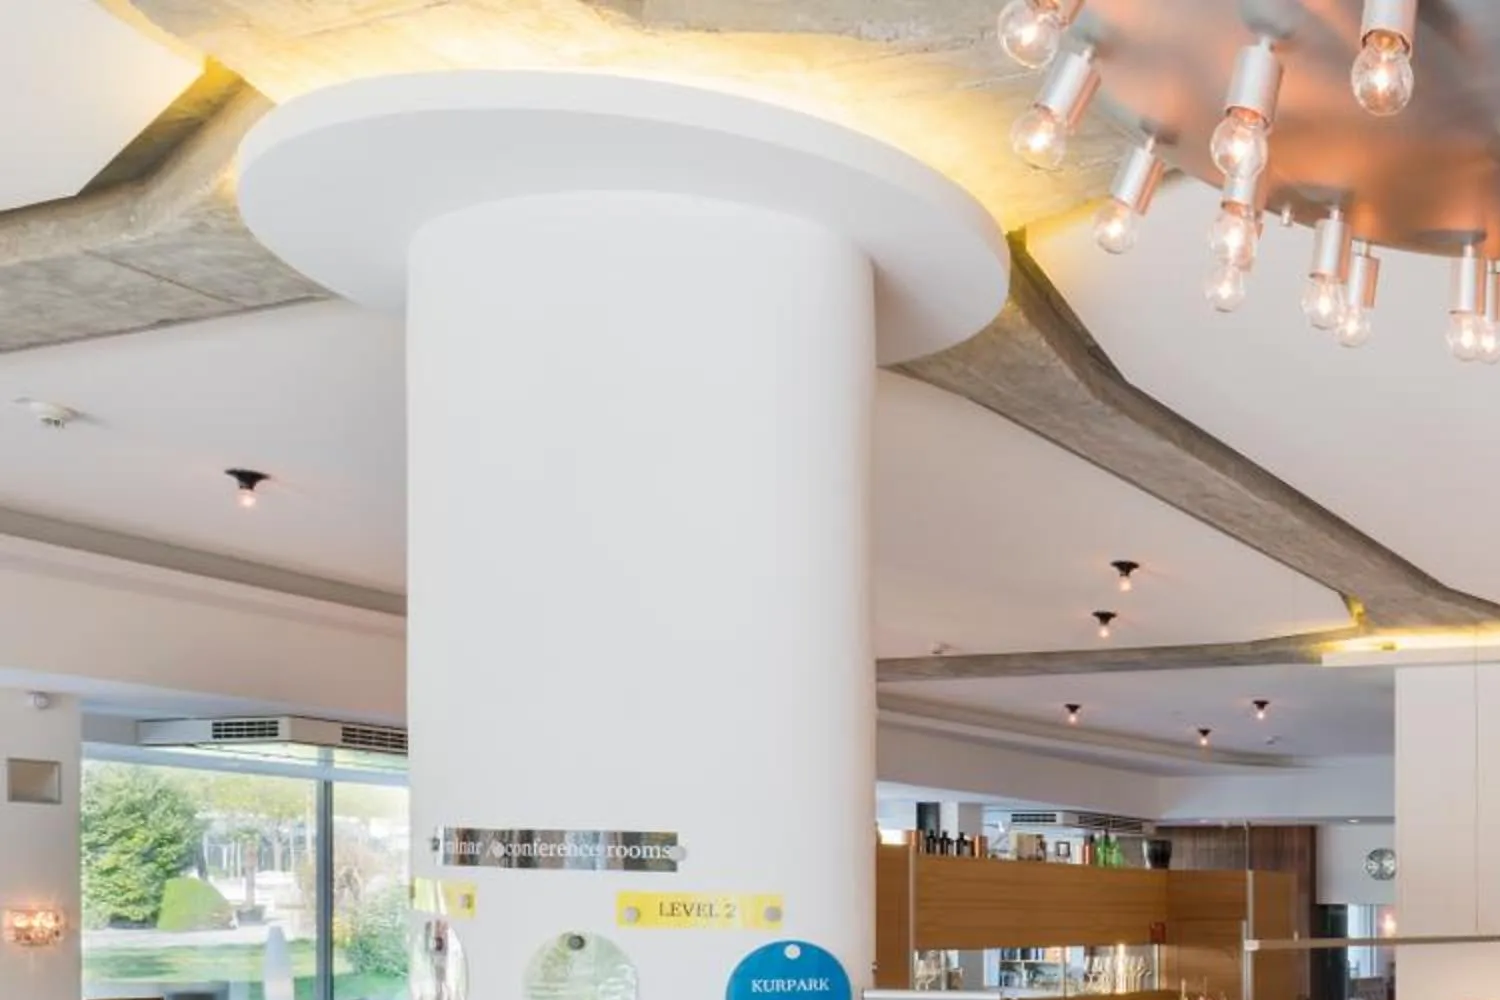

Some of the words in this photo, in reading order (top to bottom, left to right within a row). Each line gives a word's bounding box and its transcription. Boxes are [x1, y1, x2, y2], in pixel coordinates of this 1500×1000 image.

[607, 843, 672, 860] rooms
[658, 901, 719, 918] LEVEL
[724, 901, 736, 918] 2
[751, 977, 830, 993] KURPARK
